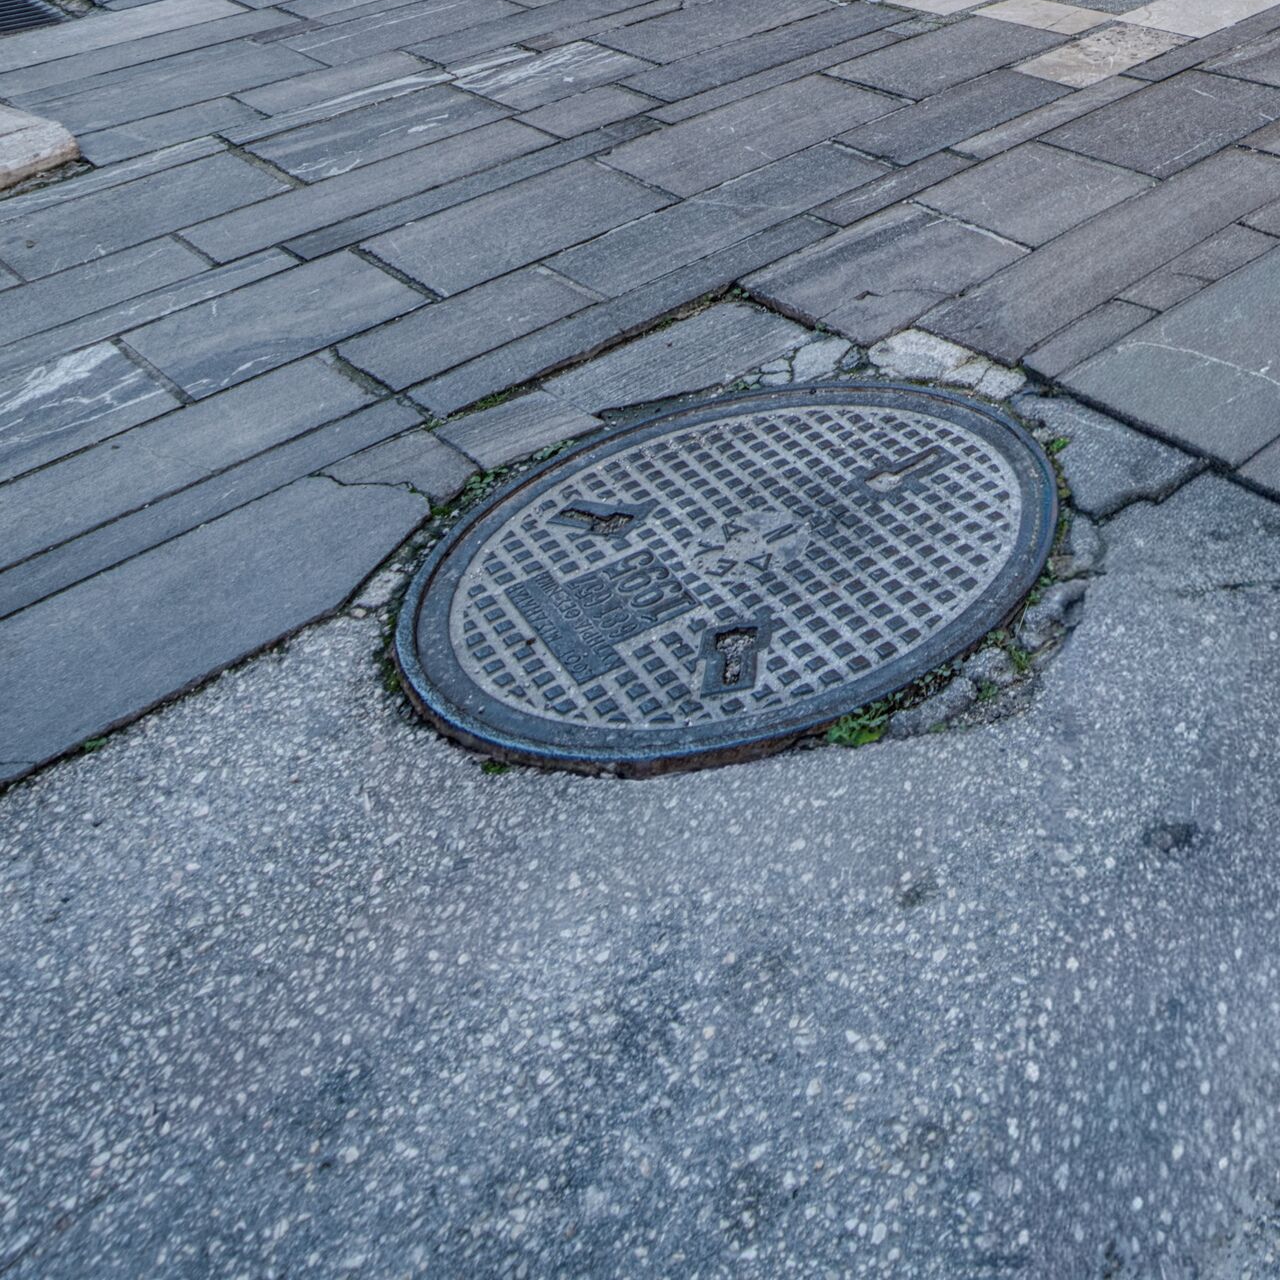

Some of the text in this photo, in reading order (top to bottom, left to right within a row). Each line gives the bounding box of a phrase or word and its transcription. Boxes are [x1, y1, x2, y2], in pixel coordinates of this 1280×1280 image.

[566, 574, 640, 640] 681 657
[602, 548, 698, 622] 1995
